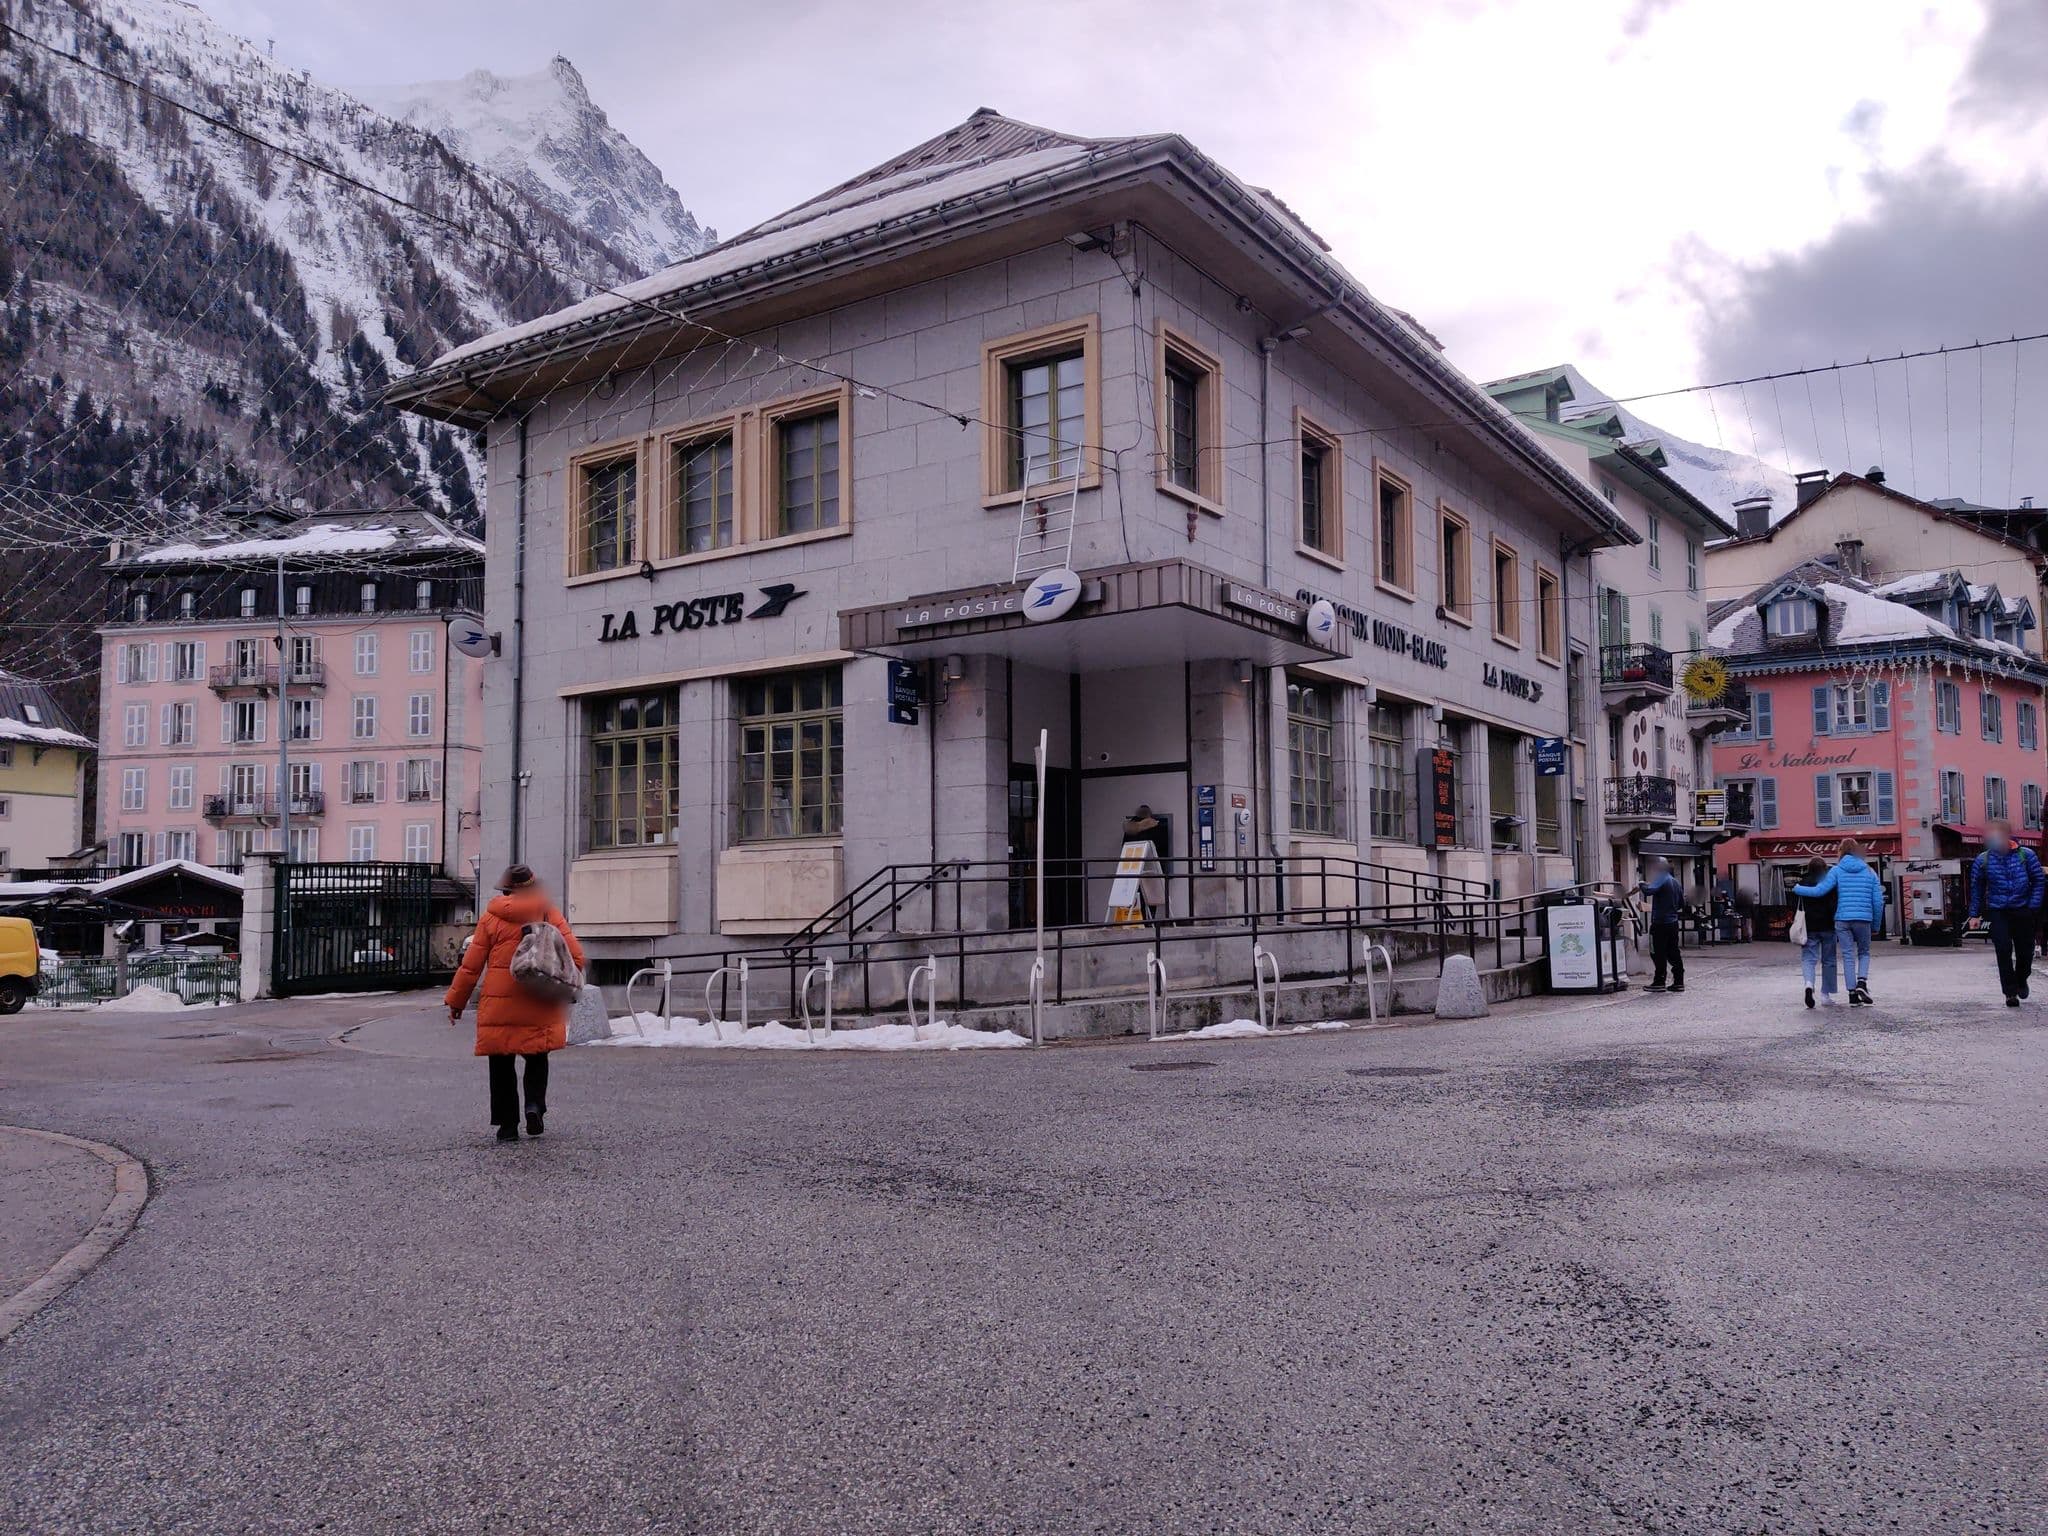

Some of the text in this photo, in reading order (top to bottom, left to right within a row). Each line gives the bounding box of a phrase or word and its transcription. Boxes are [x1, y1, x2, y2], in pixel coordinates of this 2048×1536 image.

[598, 592, 745, 642] LA POSTE
[905, 598, 1014, 625] LA POSTE
[1236, 589, 1297, 622] LA POSTE
[1373, 618, 1448, 670] MONT-BLANC
[1483, 662, 1499, 689] LA
[1738, 747, 1857, 771] Le National
[1772, 839, 1877, 855] le Natial
